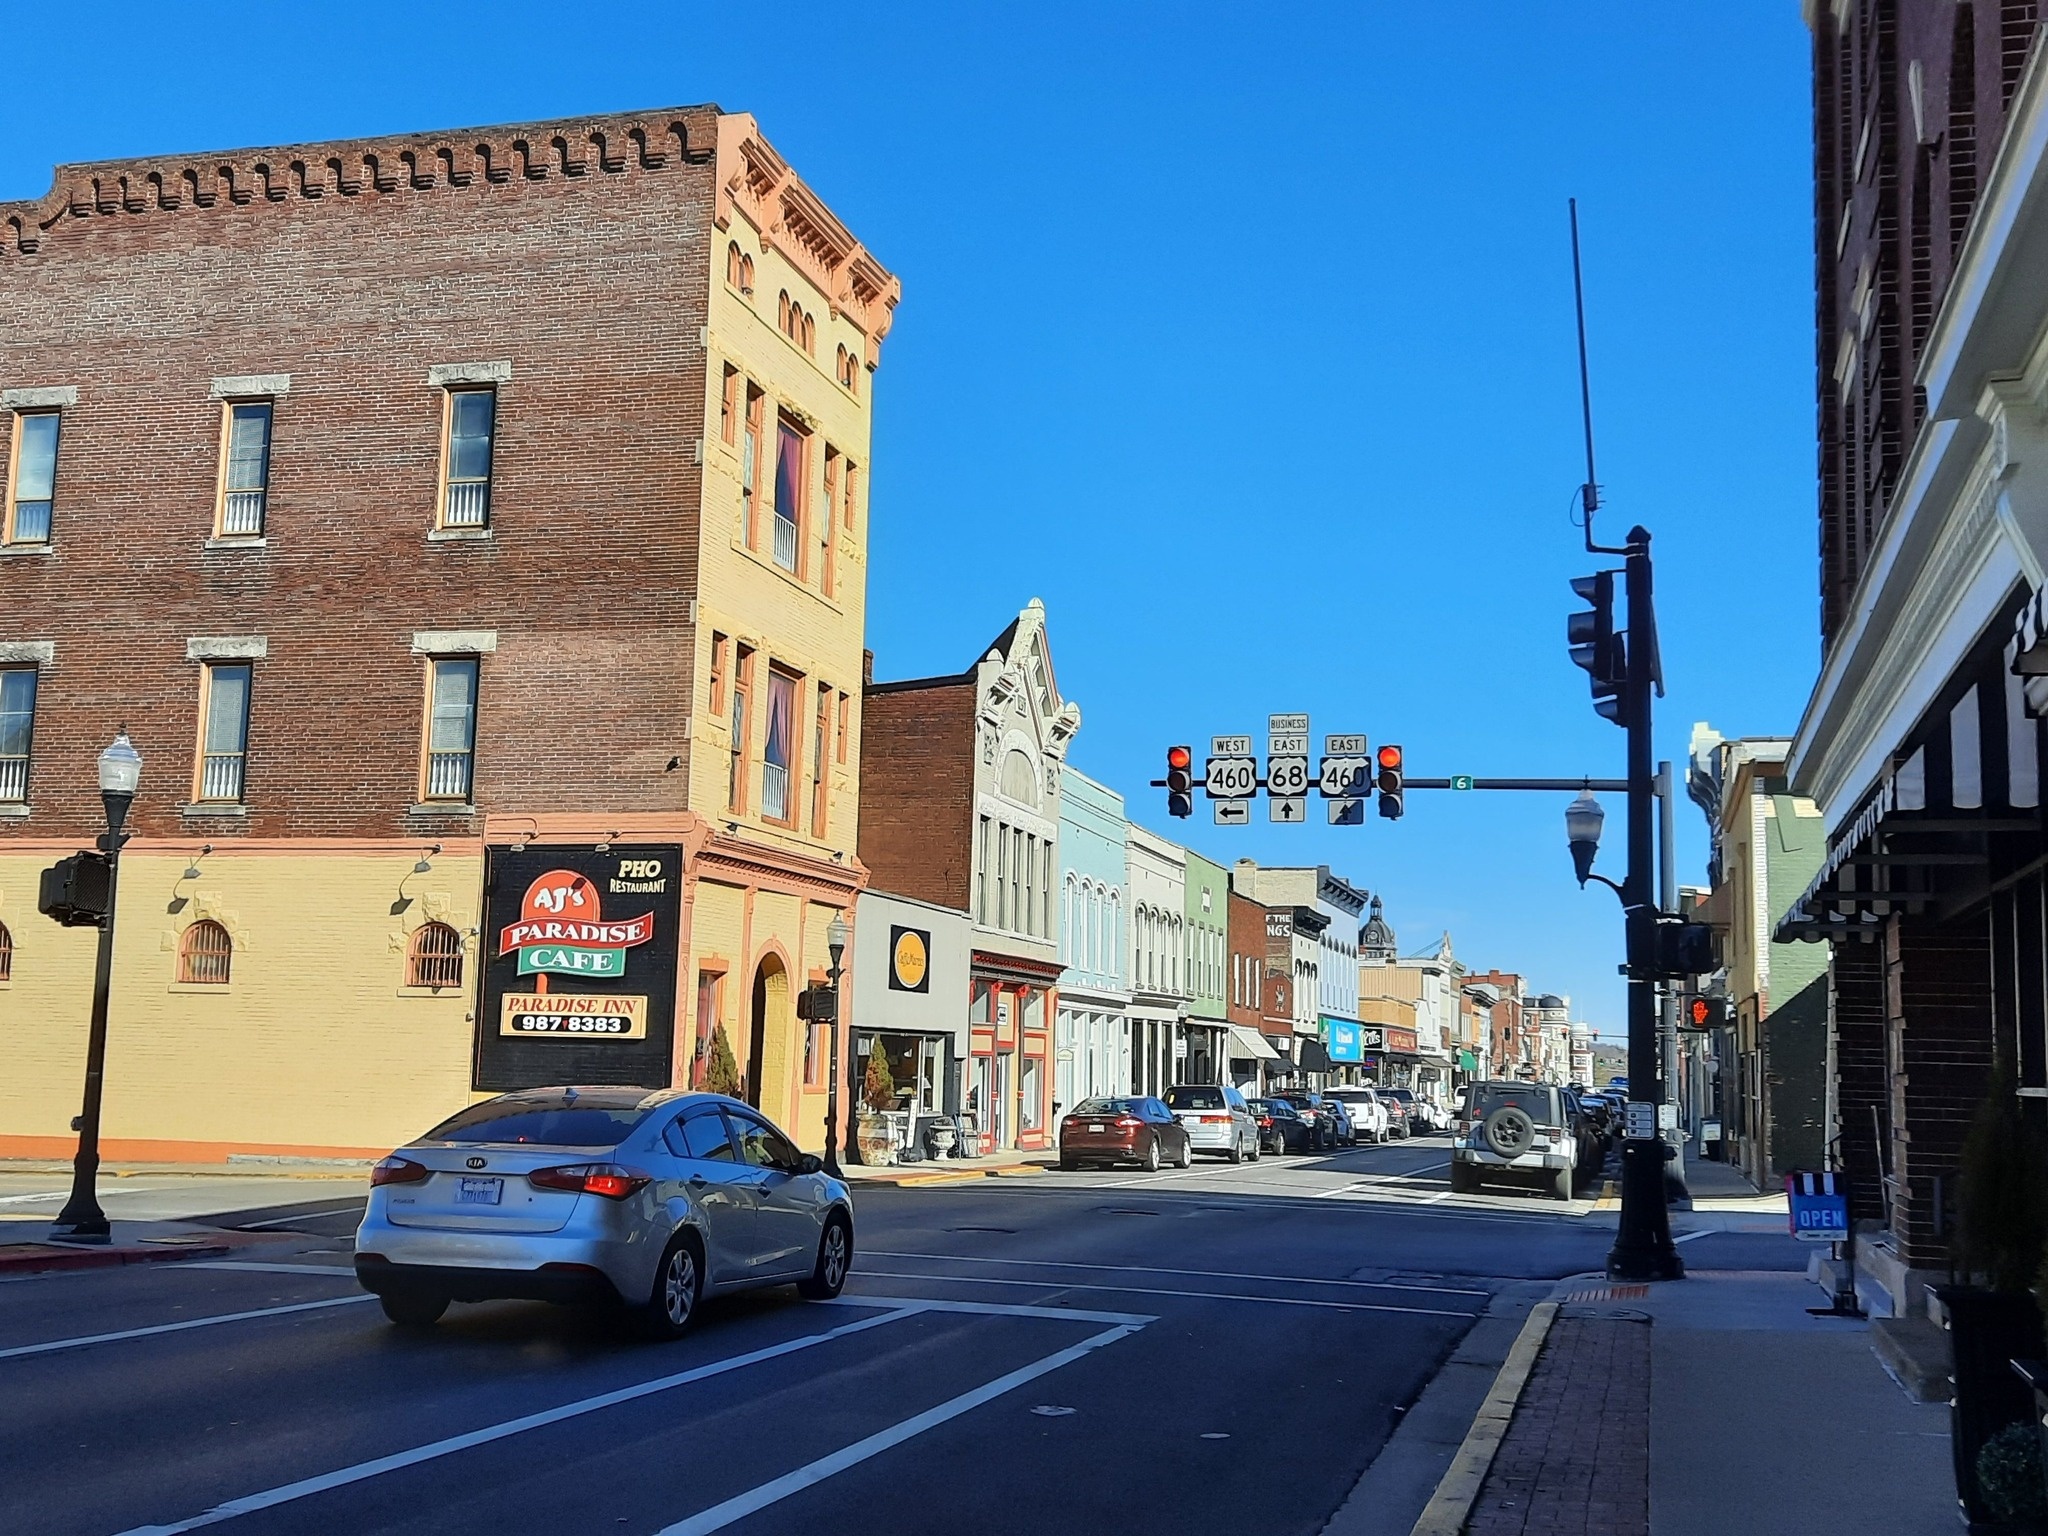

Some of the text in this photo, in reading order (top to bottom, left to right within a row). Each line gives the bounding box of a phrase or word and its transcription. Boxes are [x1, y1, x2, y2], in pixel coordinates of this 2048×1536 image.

[1271, 719, 1306, 730] BUSINESS
[1217, 740, 1246, 752] WEST
[1274, 740, 1302, 751] EAST
[1331, 739, 1360, 751] EAST
[1212, 767, 1250, 789] 460
[1273, 766, 1302, 788] 68
[1325, 766, 1364, 788] 460
[1456, 777, 1467, 789] 6
[618, 861, 661, 878] PHO
[610, 878, 666, 893] RESTAURANT
[534, 885, 585, 913] AJ's
[1273, 914, 1292, 923] THE
[511, 921, 645, 945] PARADISE
[529, 948, 614, 972] CAFE
[507, 997, 638, 1014] PARADISE INN
[1800, 1210, 1842, 1227] OPEN
